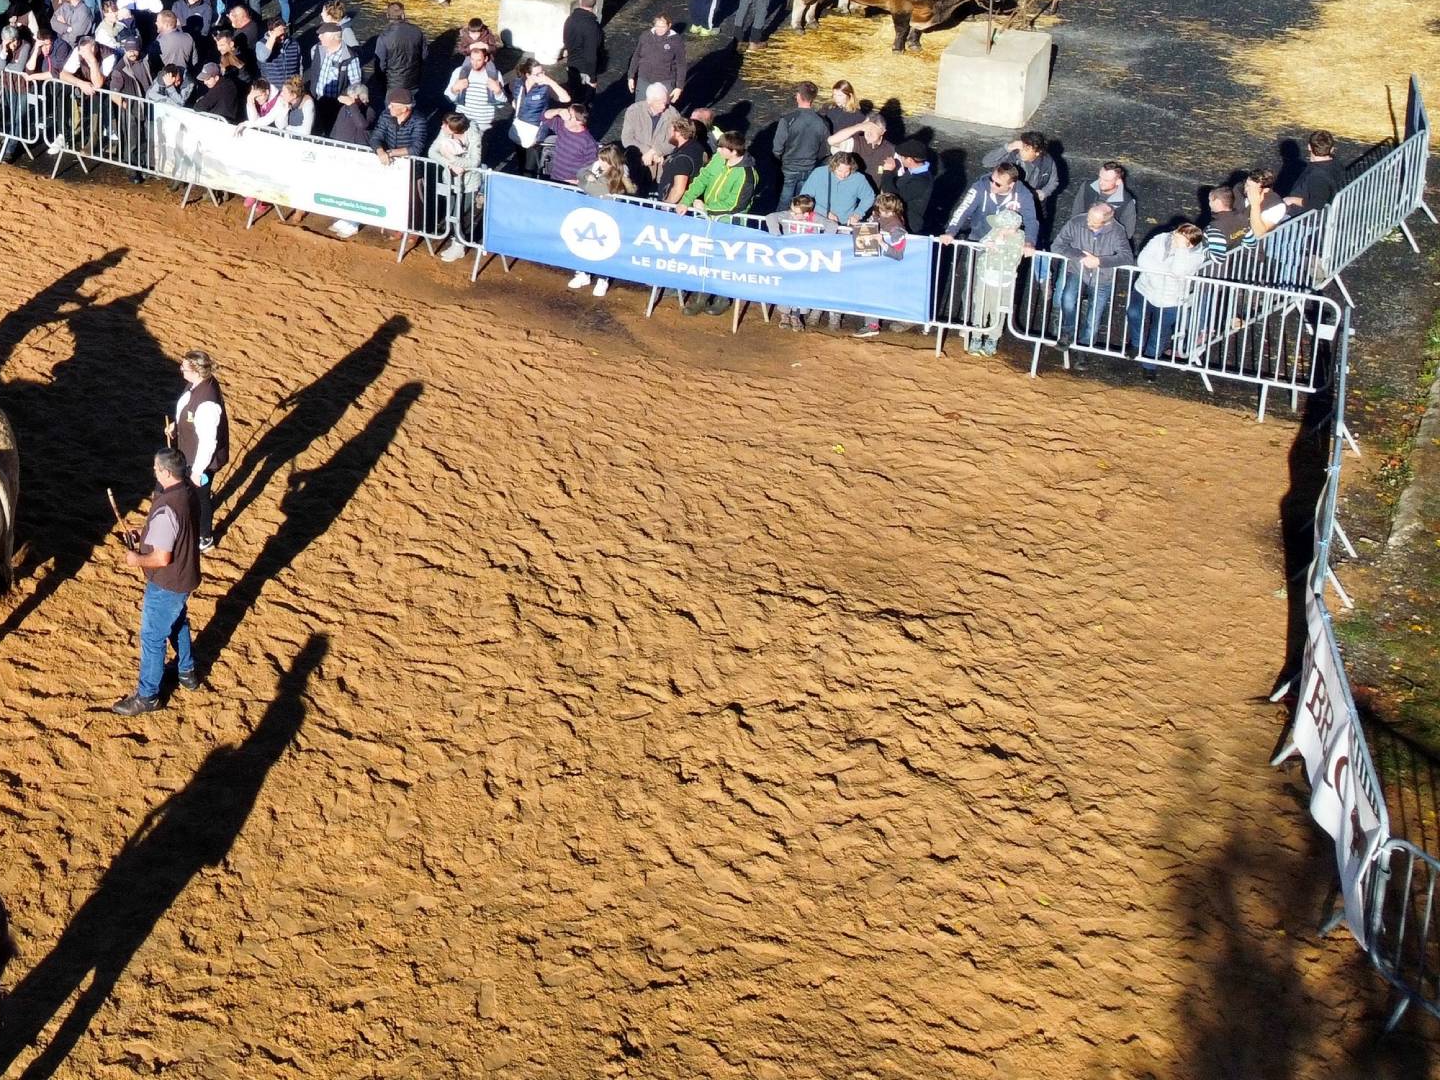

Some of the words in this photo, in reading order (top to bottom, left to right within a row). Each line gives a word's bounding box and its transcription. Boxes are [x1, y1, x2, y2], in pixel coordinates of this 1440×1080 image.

[632, 224, 842, 273] AVEYRON
[631, 255, 651, 267] LE
[655, 258, 782, 286] DÉPARTEMENT
